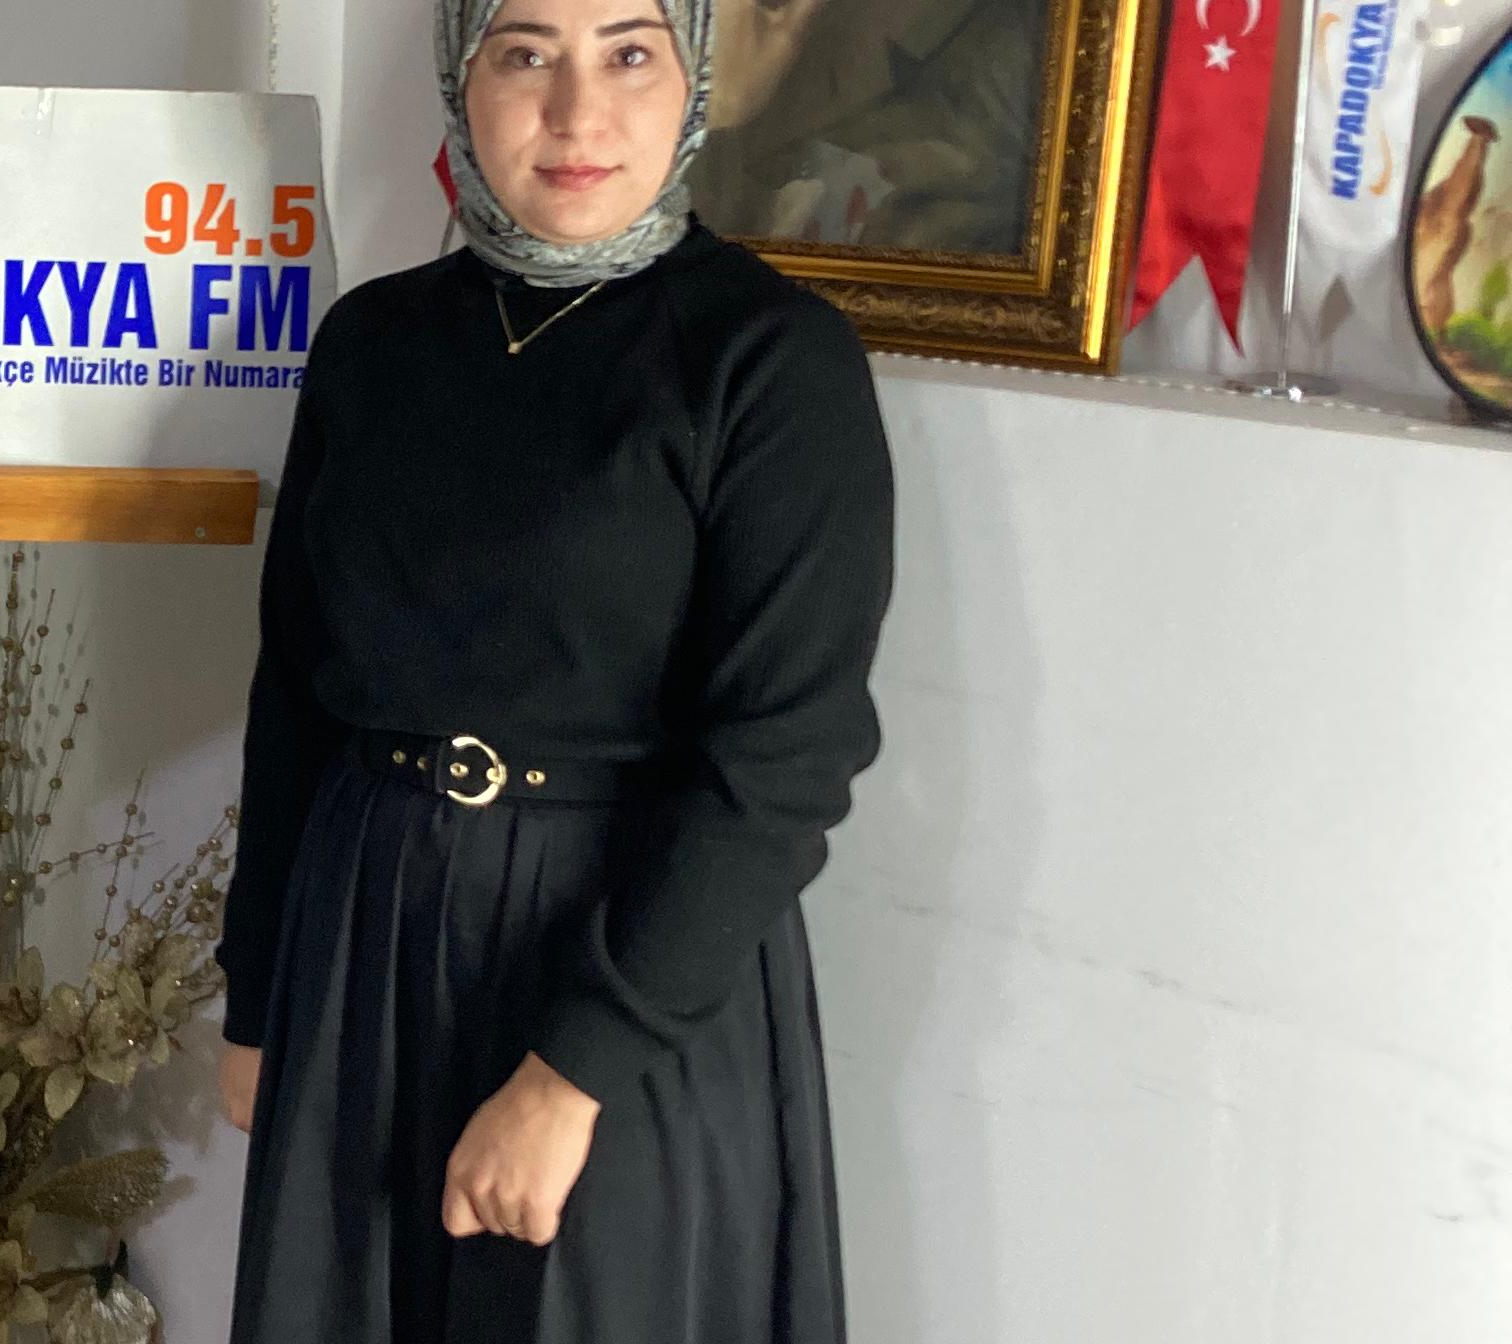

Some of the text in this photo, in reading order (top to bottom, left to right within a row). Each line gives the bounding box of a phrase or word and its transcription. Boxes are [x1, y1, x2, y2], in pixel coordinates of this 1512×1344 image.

[1331, 4, 1384, 199] KAPADOKYA
[144, 182, 315, 257] 94.5
[189, 264, 311, 352] FM
[45, 356, 148, 387] Müzikte
[158, 359, 196, 388] Bir
[204, 361, 307, 389] Numara
